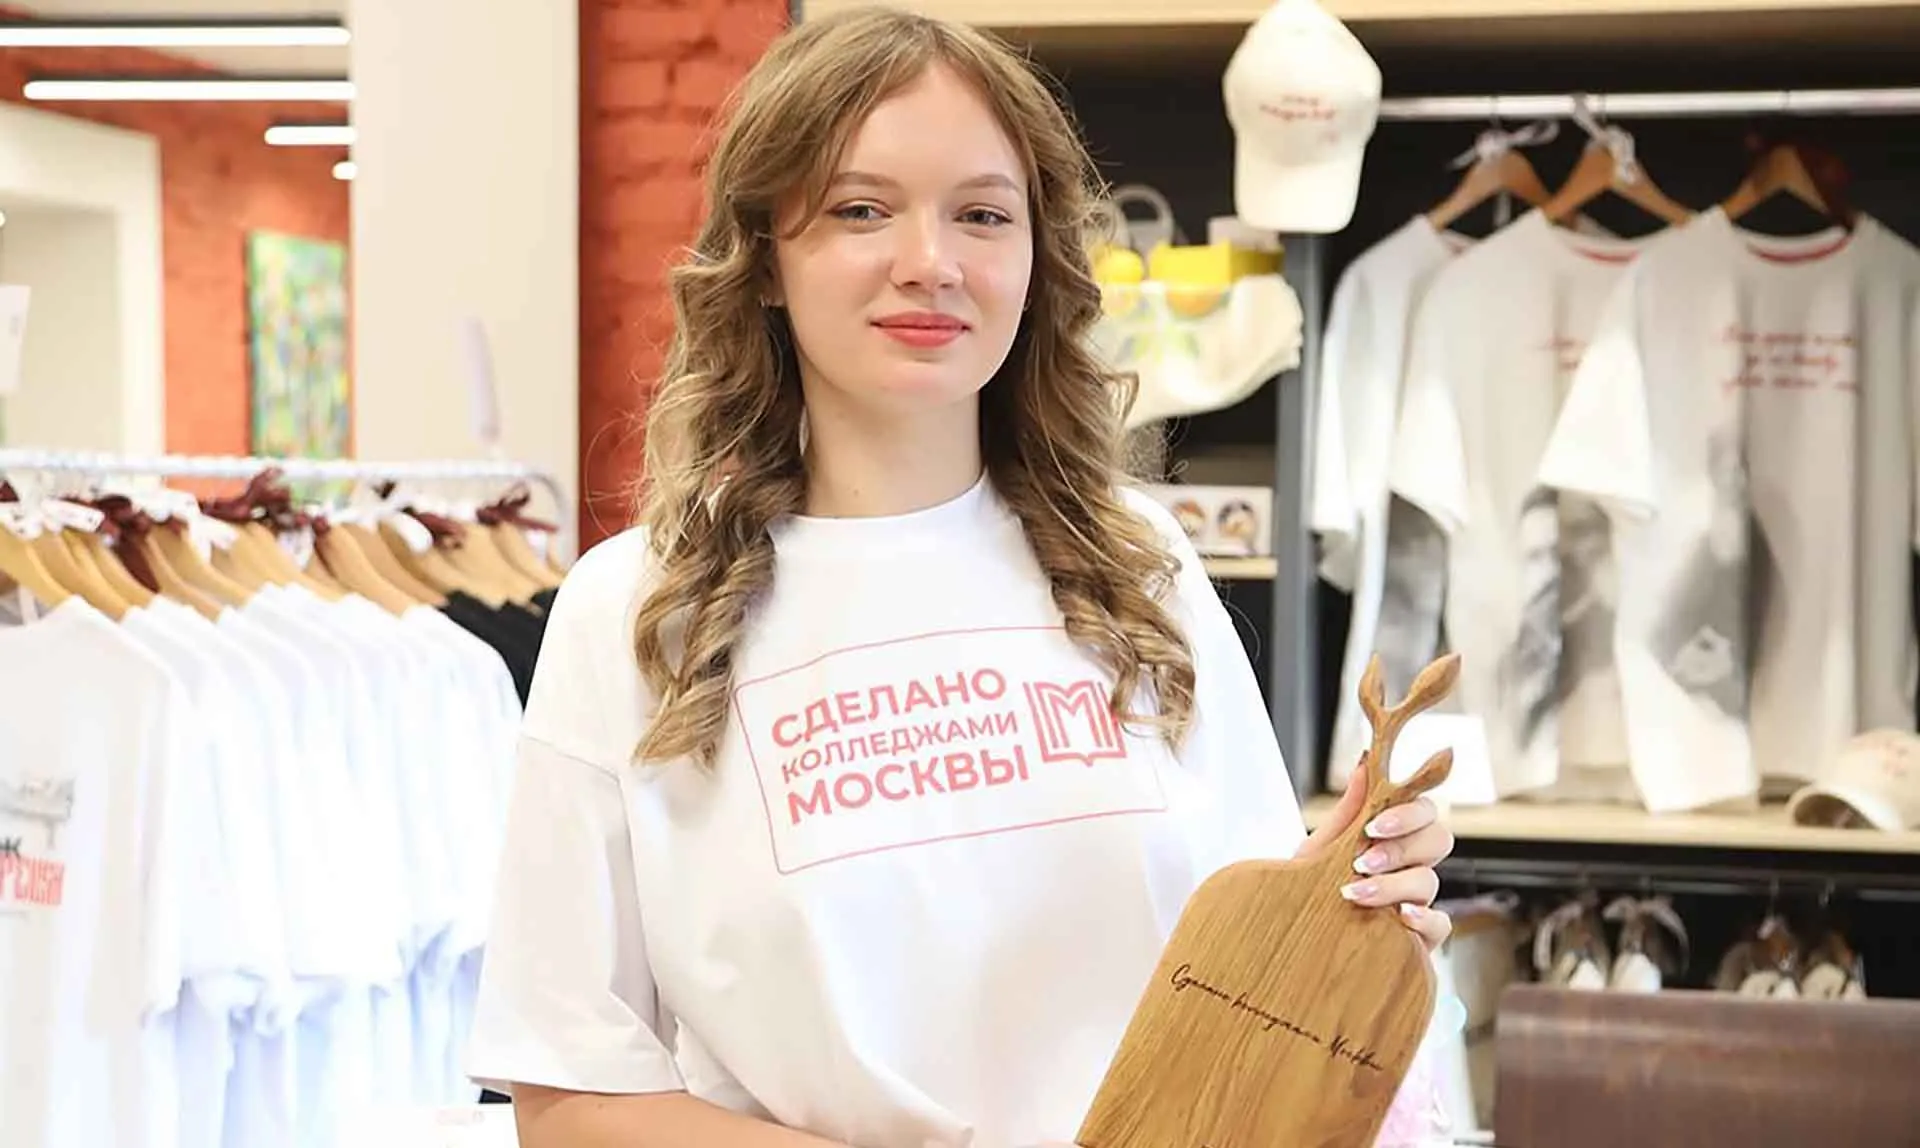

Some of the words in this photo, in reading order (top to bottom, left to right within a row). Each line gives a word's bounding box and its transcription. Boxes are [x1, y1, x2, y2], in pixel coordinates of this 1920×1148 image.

[771, 668, 1007, 748] СДЕЛАНО
[781, 710, 1019, 784] КОЛЛЕДЖАМИ
[788, 744, 1031, 825] МОСКВЫ
